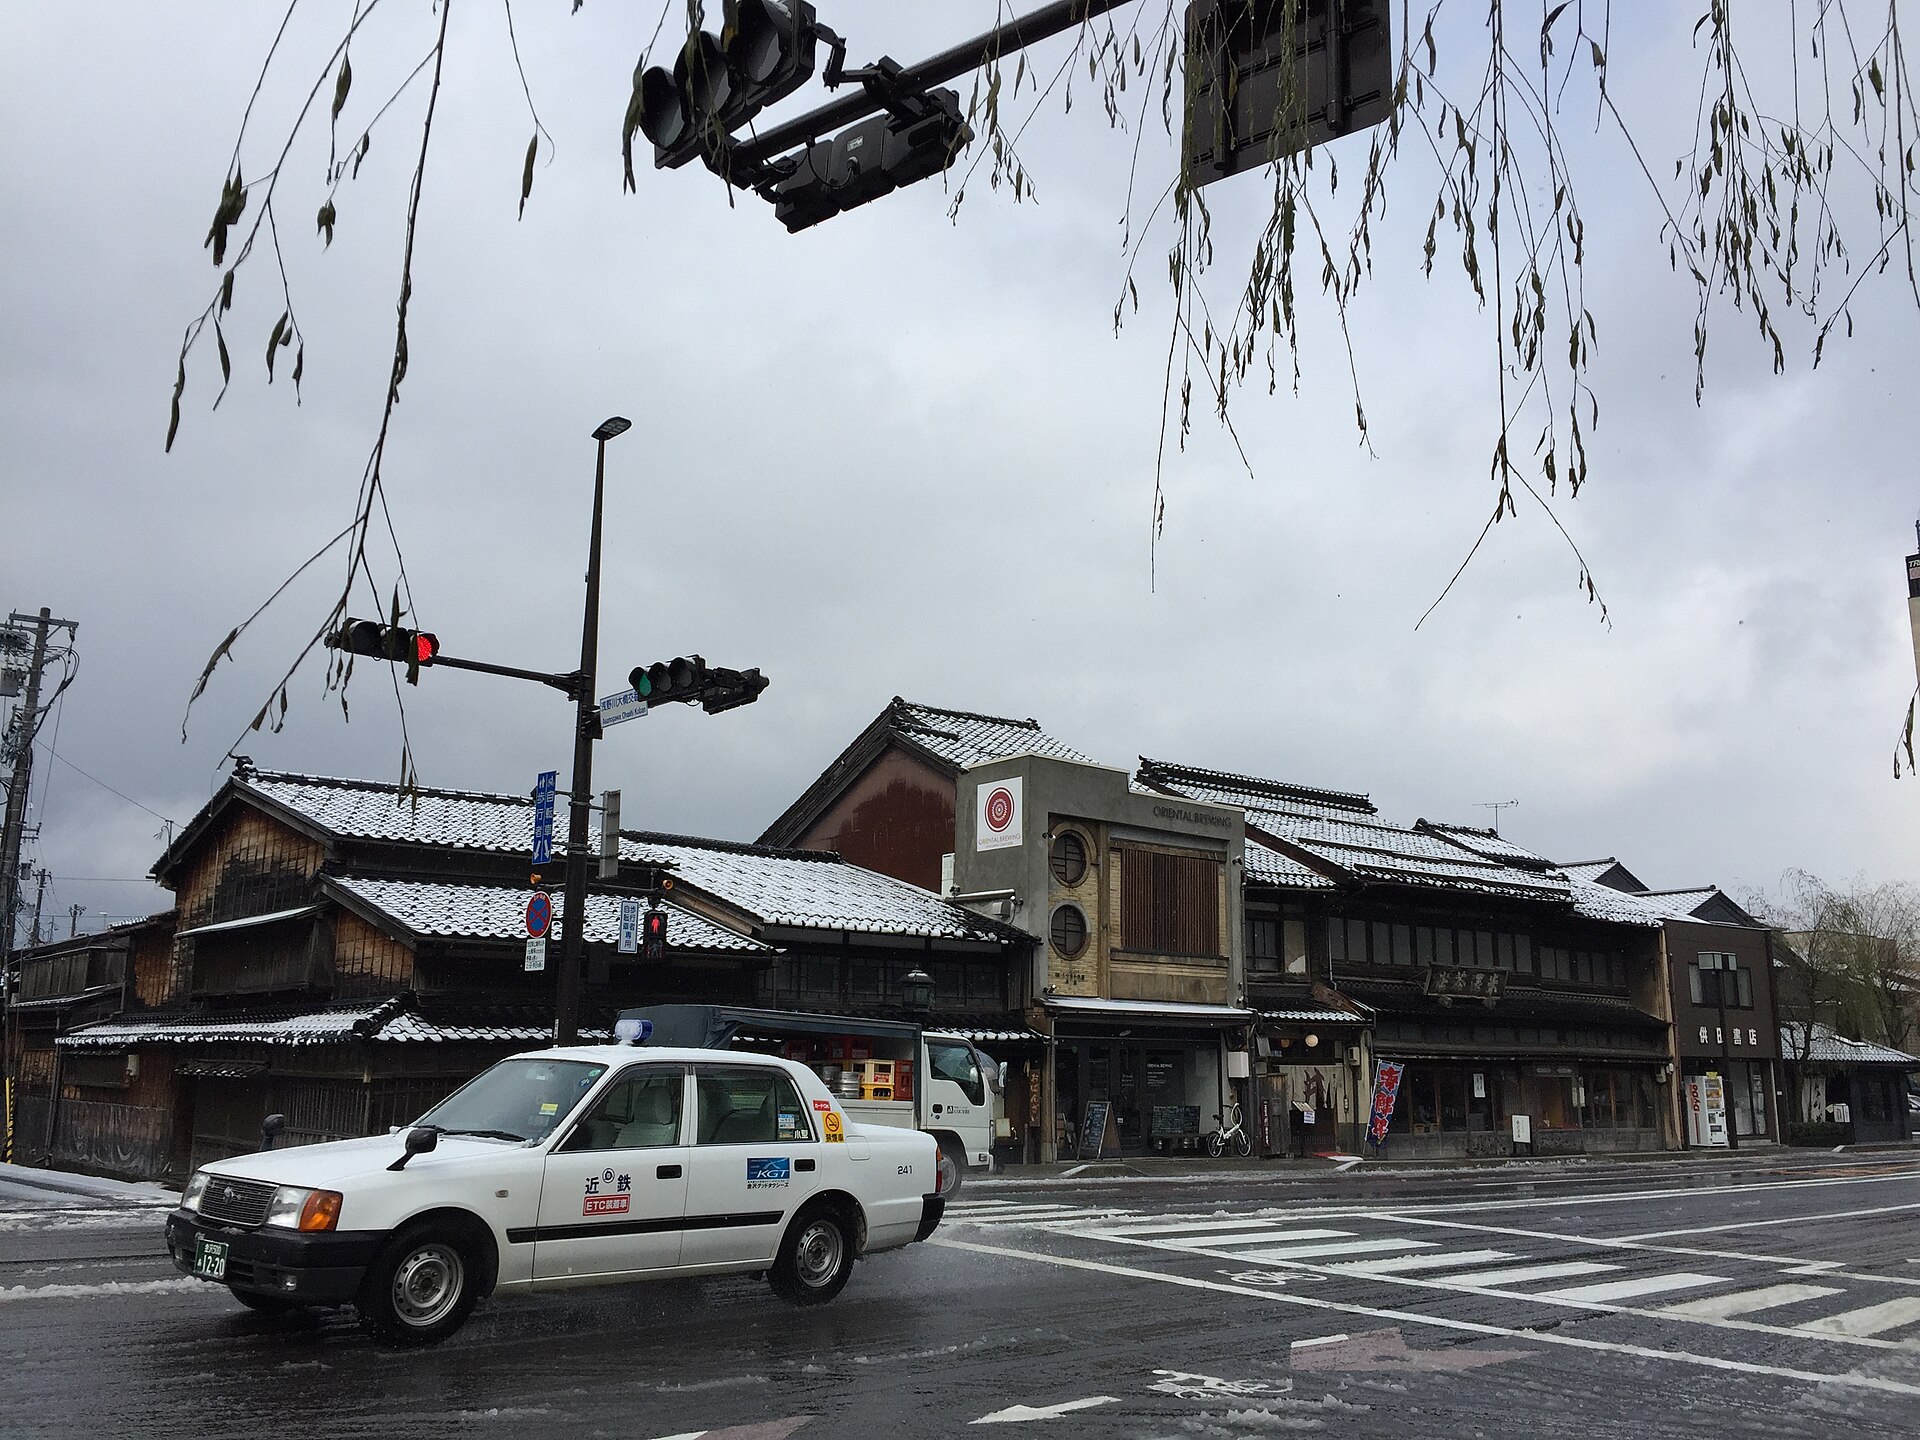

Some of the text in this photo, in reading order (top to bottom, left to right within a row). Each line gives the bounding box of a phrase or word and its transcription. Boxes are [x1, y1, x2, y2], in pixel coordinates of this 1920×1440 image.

[535, 792, 544, 838] 歩行者
[544, 790, 554, 836] 自転車
[1152, 805, 1232, 828] ORIENTAL BREWING
[624, 931, 632, 949] 専用
[1372, 1066, 1401, 1139] 海鮮丼
[1692, 1084, 1701, 1112] DyDo
[756, 1169, 789, 1179] KGT
[897, 1165, 913, 1175] 241
